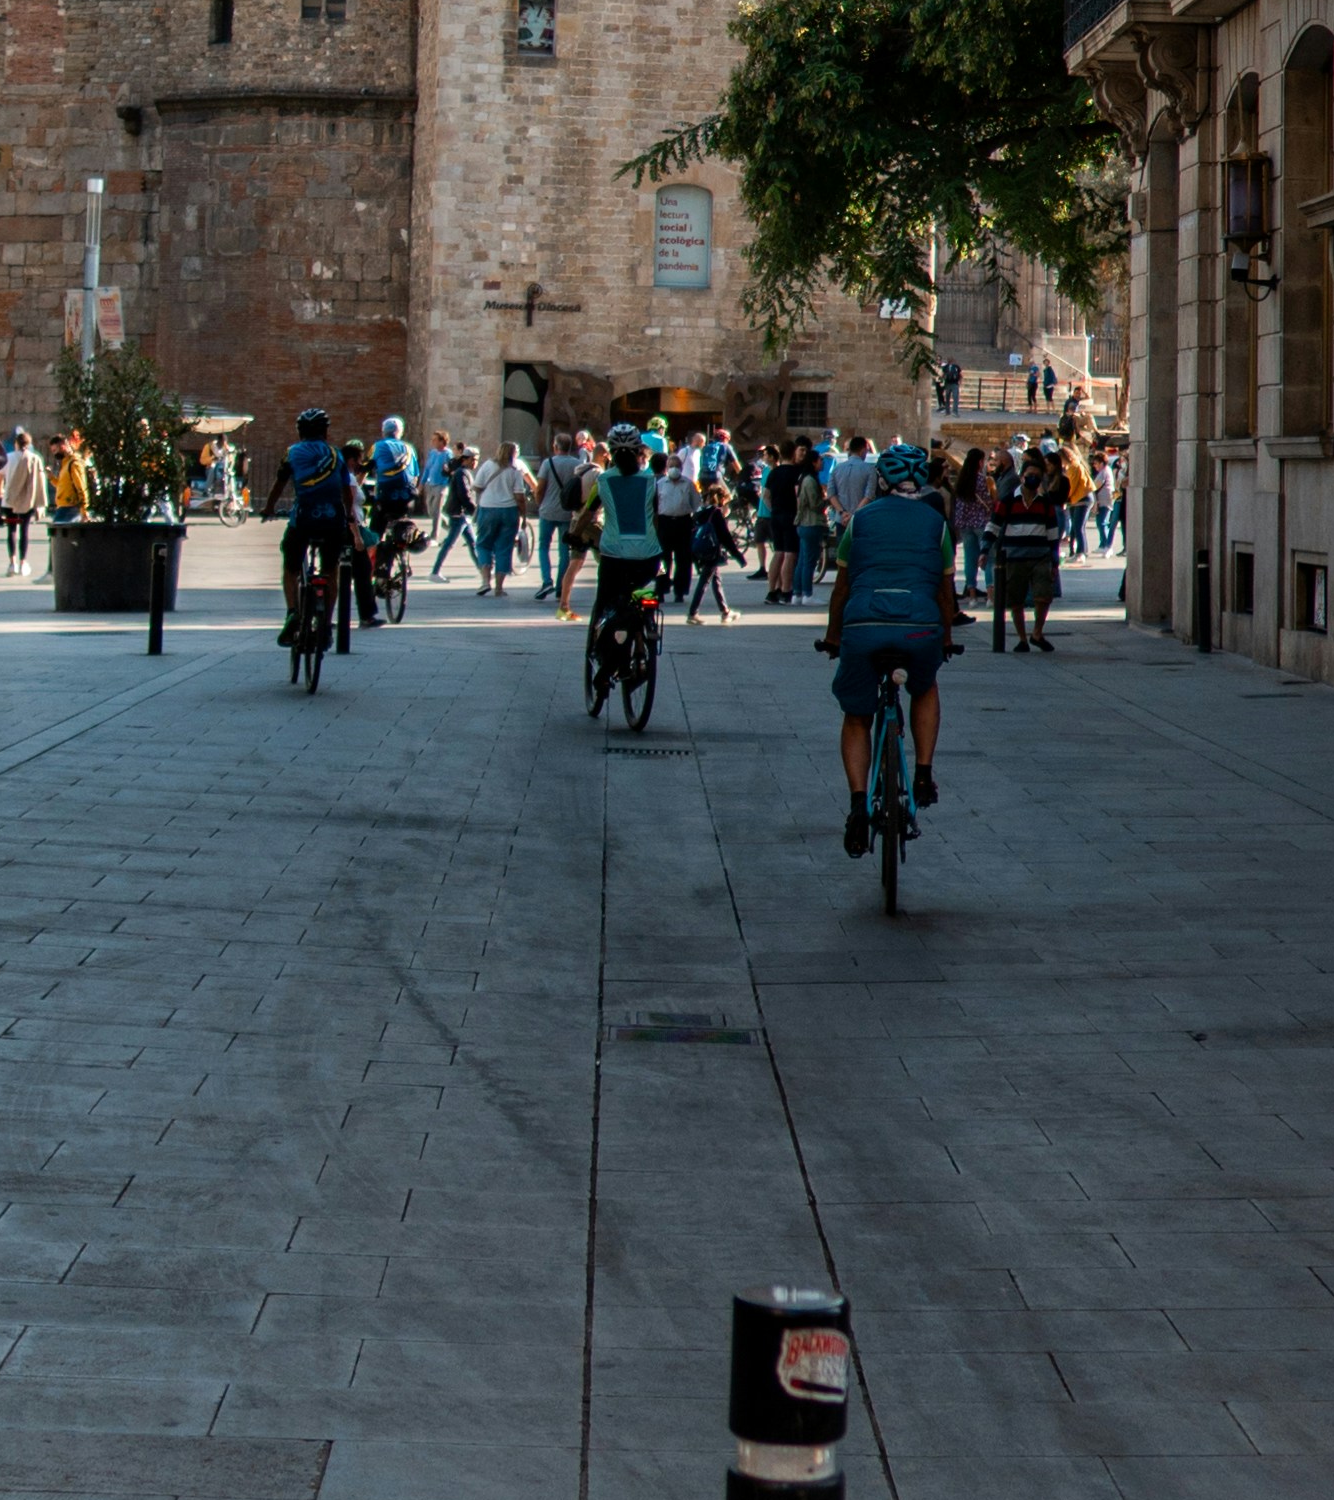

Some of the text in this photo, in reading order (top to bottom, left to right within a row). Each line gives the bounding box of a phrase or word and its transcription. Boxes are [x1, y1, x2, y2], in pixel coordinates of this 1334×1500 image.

[659, 197, 678, 206] Una
[659, 210, 690, 219] lectura
[659, 223, 687, 232] social
[658, 249, 679, 257] de la
